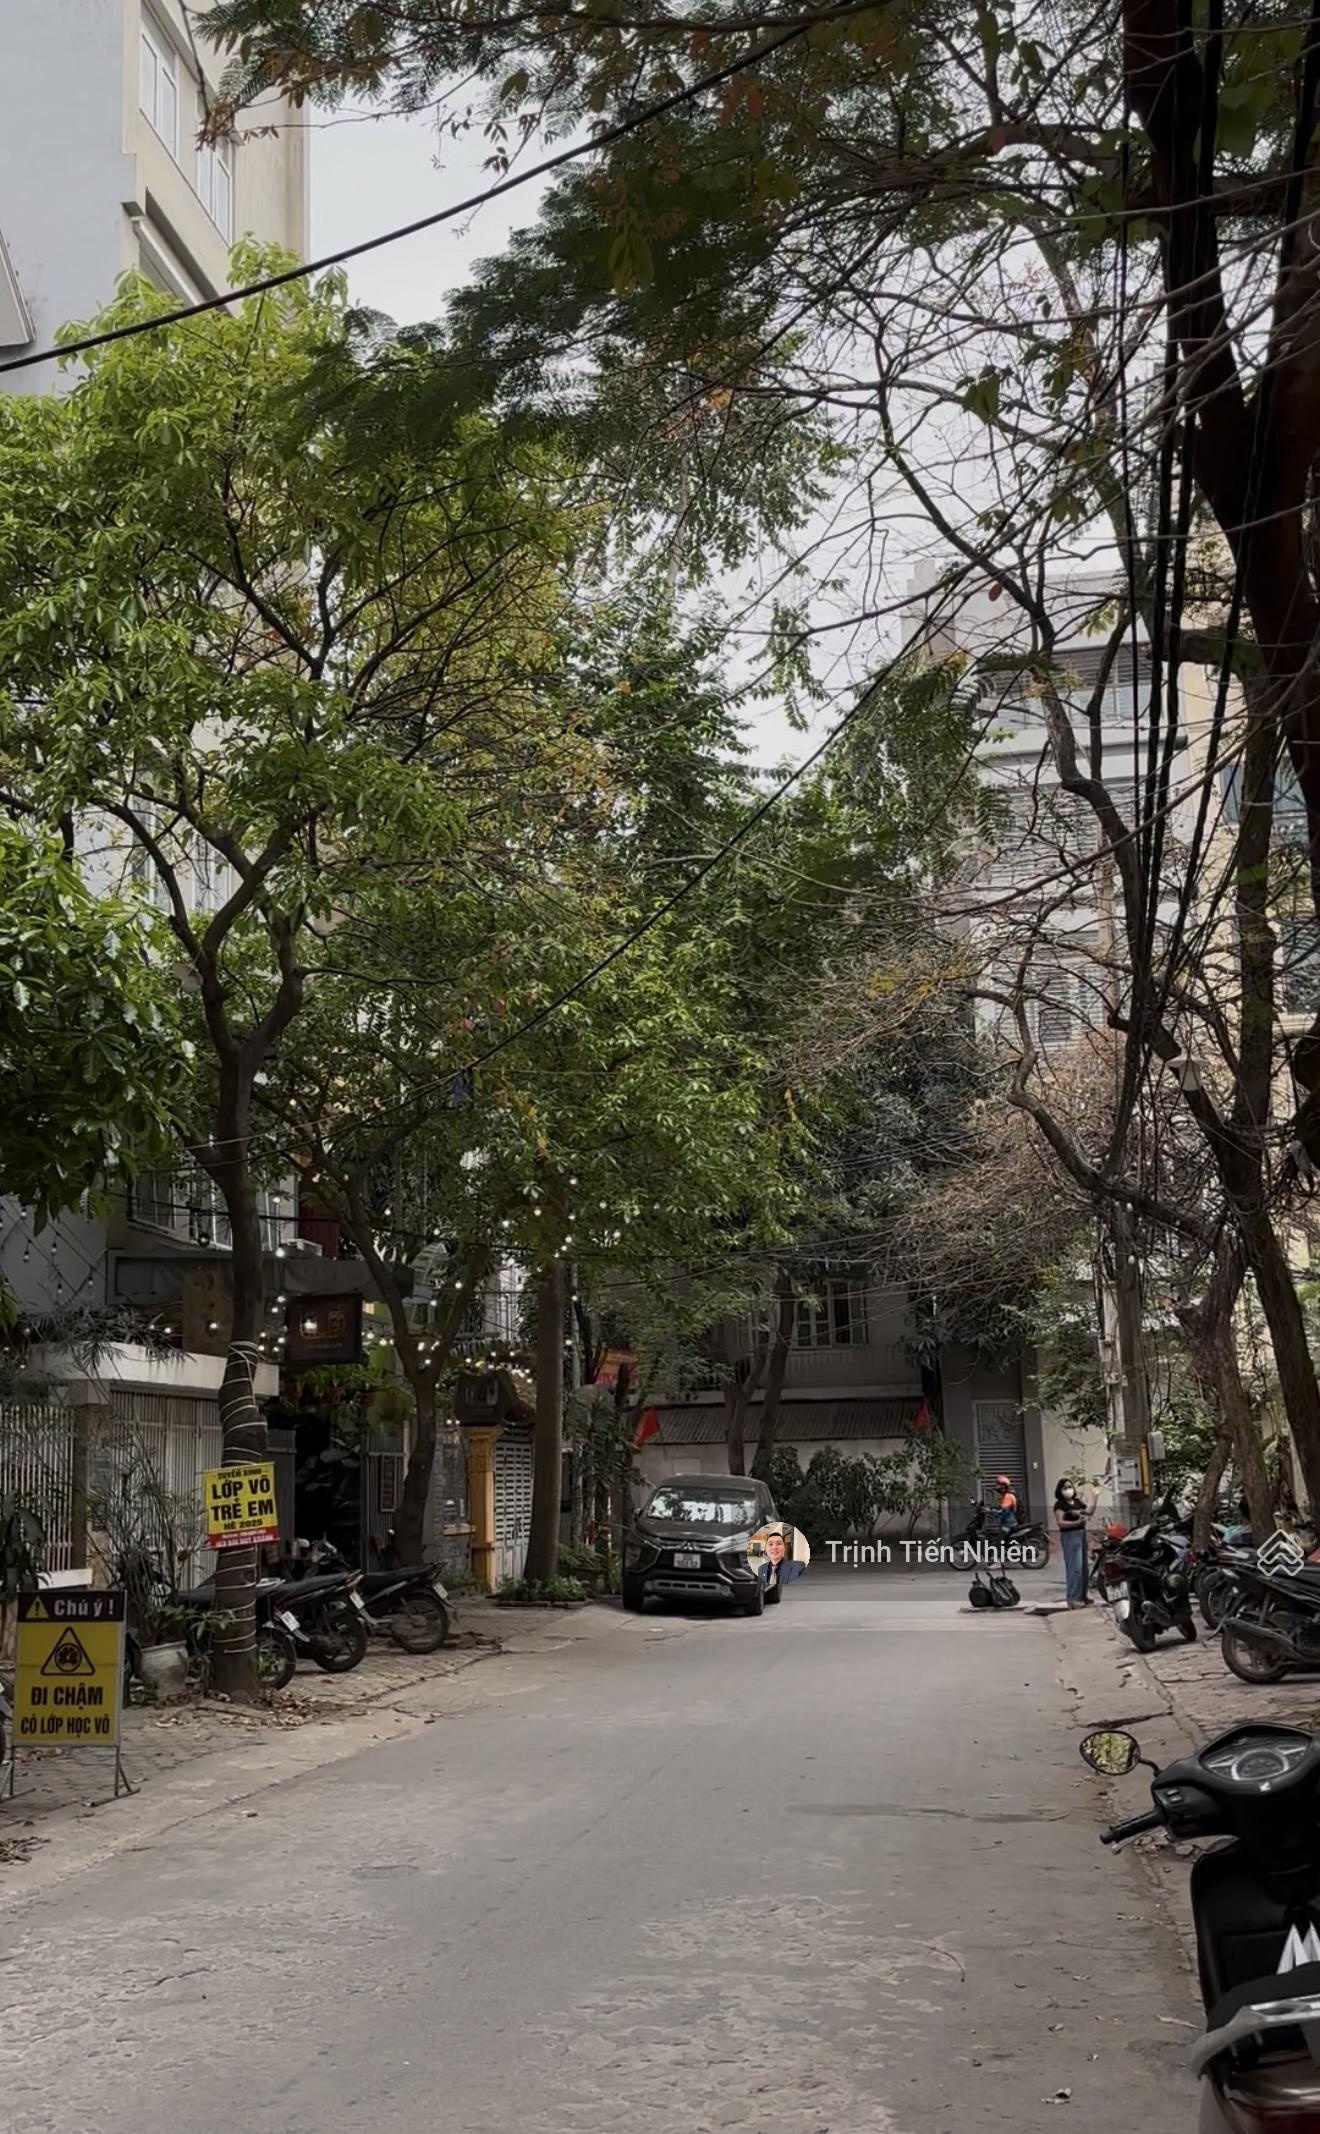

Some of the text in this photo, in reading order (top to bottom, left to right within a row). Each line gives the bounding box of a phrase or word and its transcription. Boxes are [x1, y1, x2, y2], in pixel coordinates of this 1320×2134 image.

[211, 1474, 270, 1500] LỚP VÕ
[211, 1498, 274, 1521] TRẺ EM
[239, 1518, 263, 1528] 2025
[54, 1599, 87, 1616] Chú
[31, 1682, 103, 1710] ĐI CHẬM
[21, 1713, 38, 1734] CÓ
[40, 1713, 63, 1734] LỚP
[66, 1717, 90, 1738] HỌC
